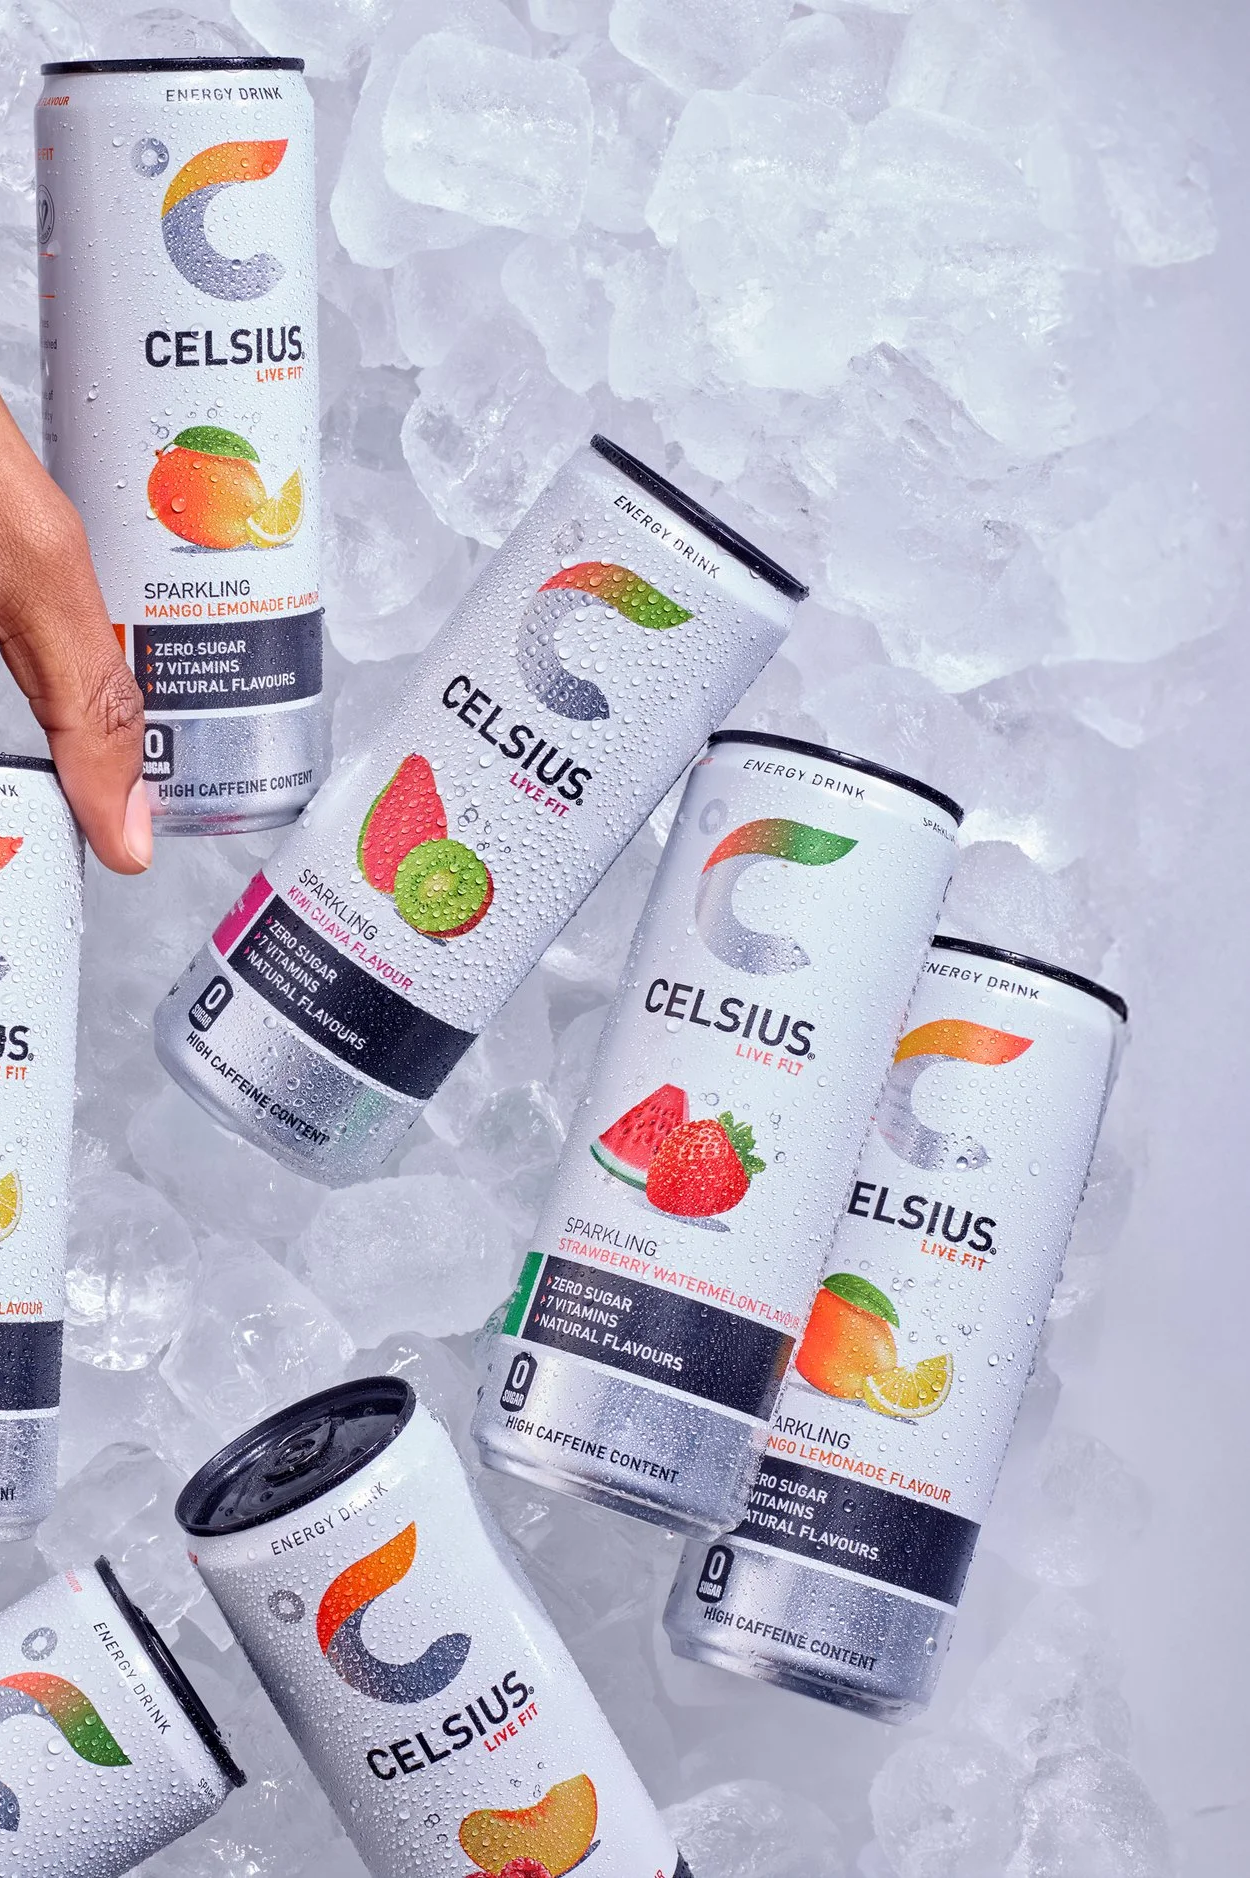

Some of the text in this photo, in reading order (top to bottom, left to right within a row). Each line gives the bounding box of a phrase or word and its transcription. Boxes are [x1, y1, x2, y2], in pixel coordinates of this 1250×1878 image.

[166, 88, 282, 102] ENERGY DRINK
[145, 325, 302, 368] CELSIUS
[257, 367, 302, 382] LIVE FIT
[614, 495, 720, 578] ENERGY DRINK
[144, 580, 250, 600] SPARKLING
[145, 603, 202, 618] MANGO
[207, 598, 284, 617] LEMONADE
[155, 640, 246, 656] ZERO SUGAR
[167, 660, 240, 675] VITAMINS
[156, 673, 295, 695] NATURAL FLAVOURS
[443, 675, 592, 802] CELSIUS
[159, 769, 313, 797] HIGH CAFFEINE CONTENT
[509, 773, 569, 818] LIVE FIT
[743, 759, 865, 800] ENERGY DRINK
[298, 869, 377, 941] SPARKLING
[269, 921, 338, 983] ZERO SUGAR
[287, 886, 311, 912] KIWI
[310, 907, 350, 947] GUAVA
[350, 942, 413, 991] FLAVOUR
[265, 941, 320, 994] VITAMINS
[987, 976, 1040, 1000] DRINK
[191, 1004, 212, 1029] SUGAR
[247, 952, 367, 1050] NATURAL FLAVOURS
[645, 978, 815, 1056] CELSIUS
[6, 1065, 26, 1080] FIT
[736, 1044, 804, 1076] LIVE FIT
[187, 1031, 329, 1146] HIGH CAFFEINE CONTENT
[564, 1217, 656, 1257] SPARKLING
[847, 1180, 996, 1252] ELSIUS
[921, 1239, 986, 1272] LIVE FIT
[552, 1276, 632, 1313] ZERO SUGAR
[558, 1238, 800, 1328] STRAWBERRY WATERMELON FLAVOUR
[555, 1298, 618, 1328] VITAMINS
[539, 1313, 683, 1372] NATURAL FLAVOURS
[502, 1388, 526, 1407] SUGAR
[506, 1416, 679, 1483] HIGH CAFFEINE CONTENT
[773, 1415, 850, 1449] ARKLING
[756, 1473, 828, 1505] ERO SUGAR
[767, 1435, 951, 1503] NGO LEMONADE FLAVOUR
[750, 1490, 814, 1520] VITAMINS
[270, 1513, 337, 1556] ENERGY
[744, 1508, 879, 1561] ATURAL FLAVOURS
[699, 1581, 722, 1600] SUGAR
[704, 1607, 877, 1672] HIGH CAFFEINE CONTENT
[93, 1622, 172, 1735] ENERGY DRINK
[366, 1670, 531, 1781] CELSIUS
[484, 1702, 540, 1753] LIVE FIT
